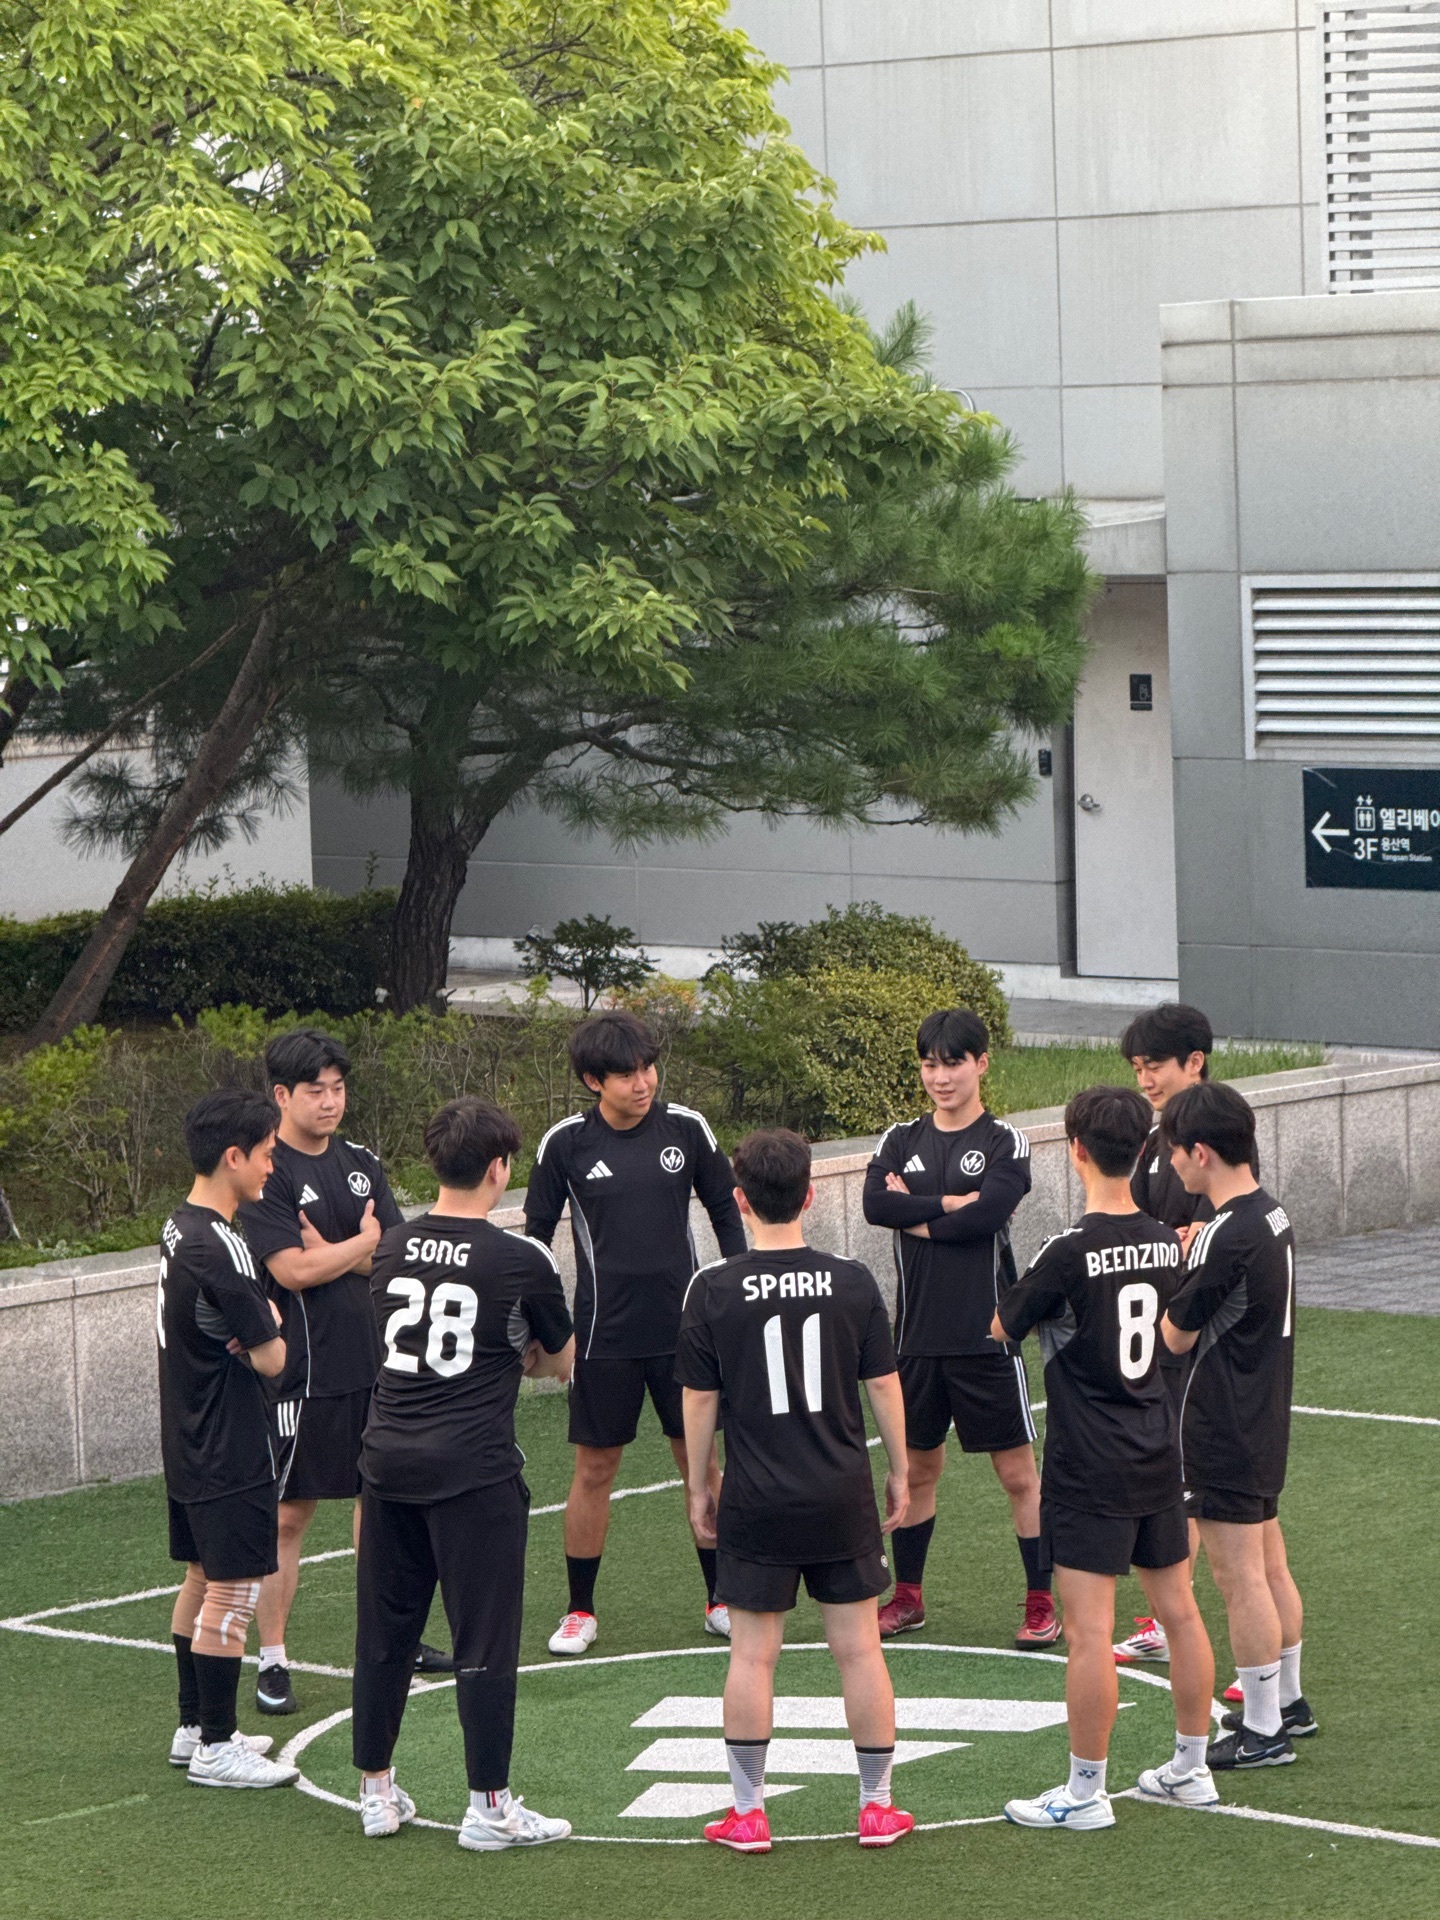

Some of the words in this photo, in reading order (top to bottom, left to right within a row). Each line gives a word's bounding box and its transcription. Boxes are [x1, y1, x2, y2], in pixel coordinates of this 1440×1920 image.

[1354, 837, 1379, 860] 3F
[1381, 837, 1409, 851] 용산역
[405, 1238, 471, 1266] SONG
[1086, 1242, 1179, 1277] BEENZINO
[743, 1271, 832, 1301] SPARK
[383, 1277, 478, 1377] 28
[1118, 1283, 1158, 1379] 8
[764, 1313, 822, 1414] 11
